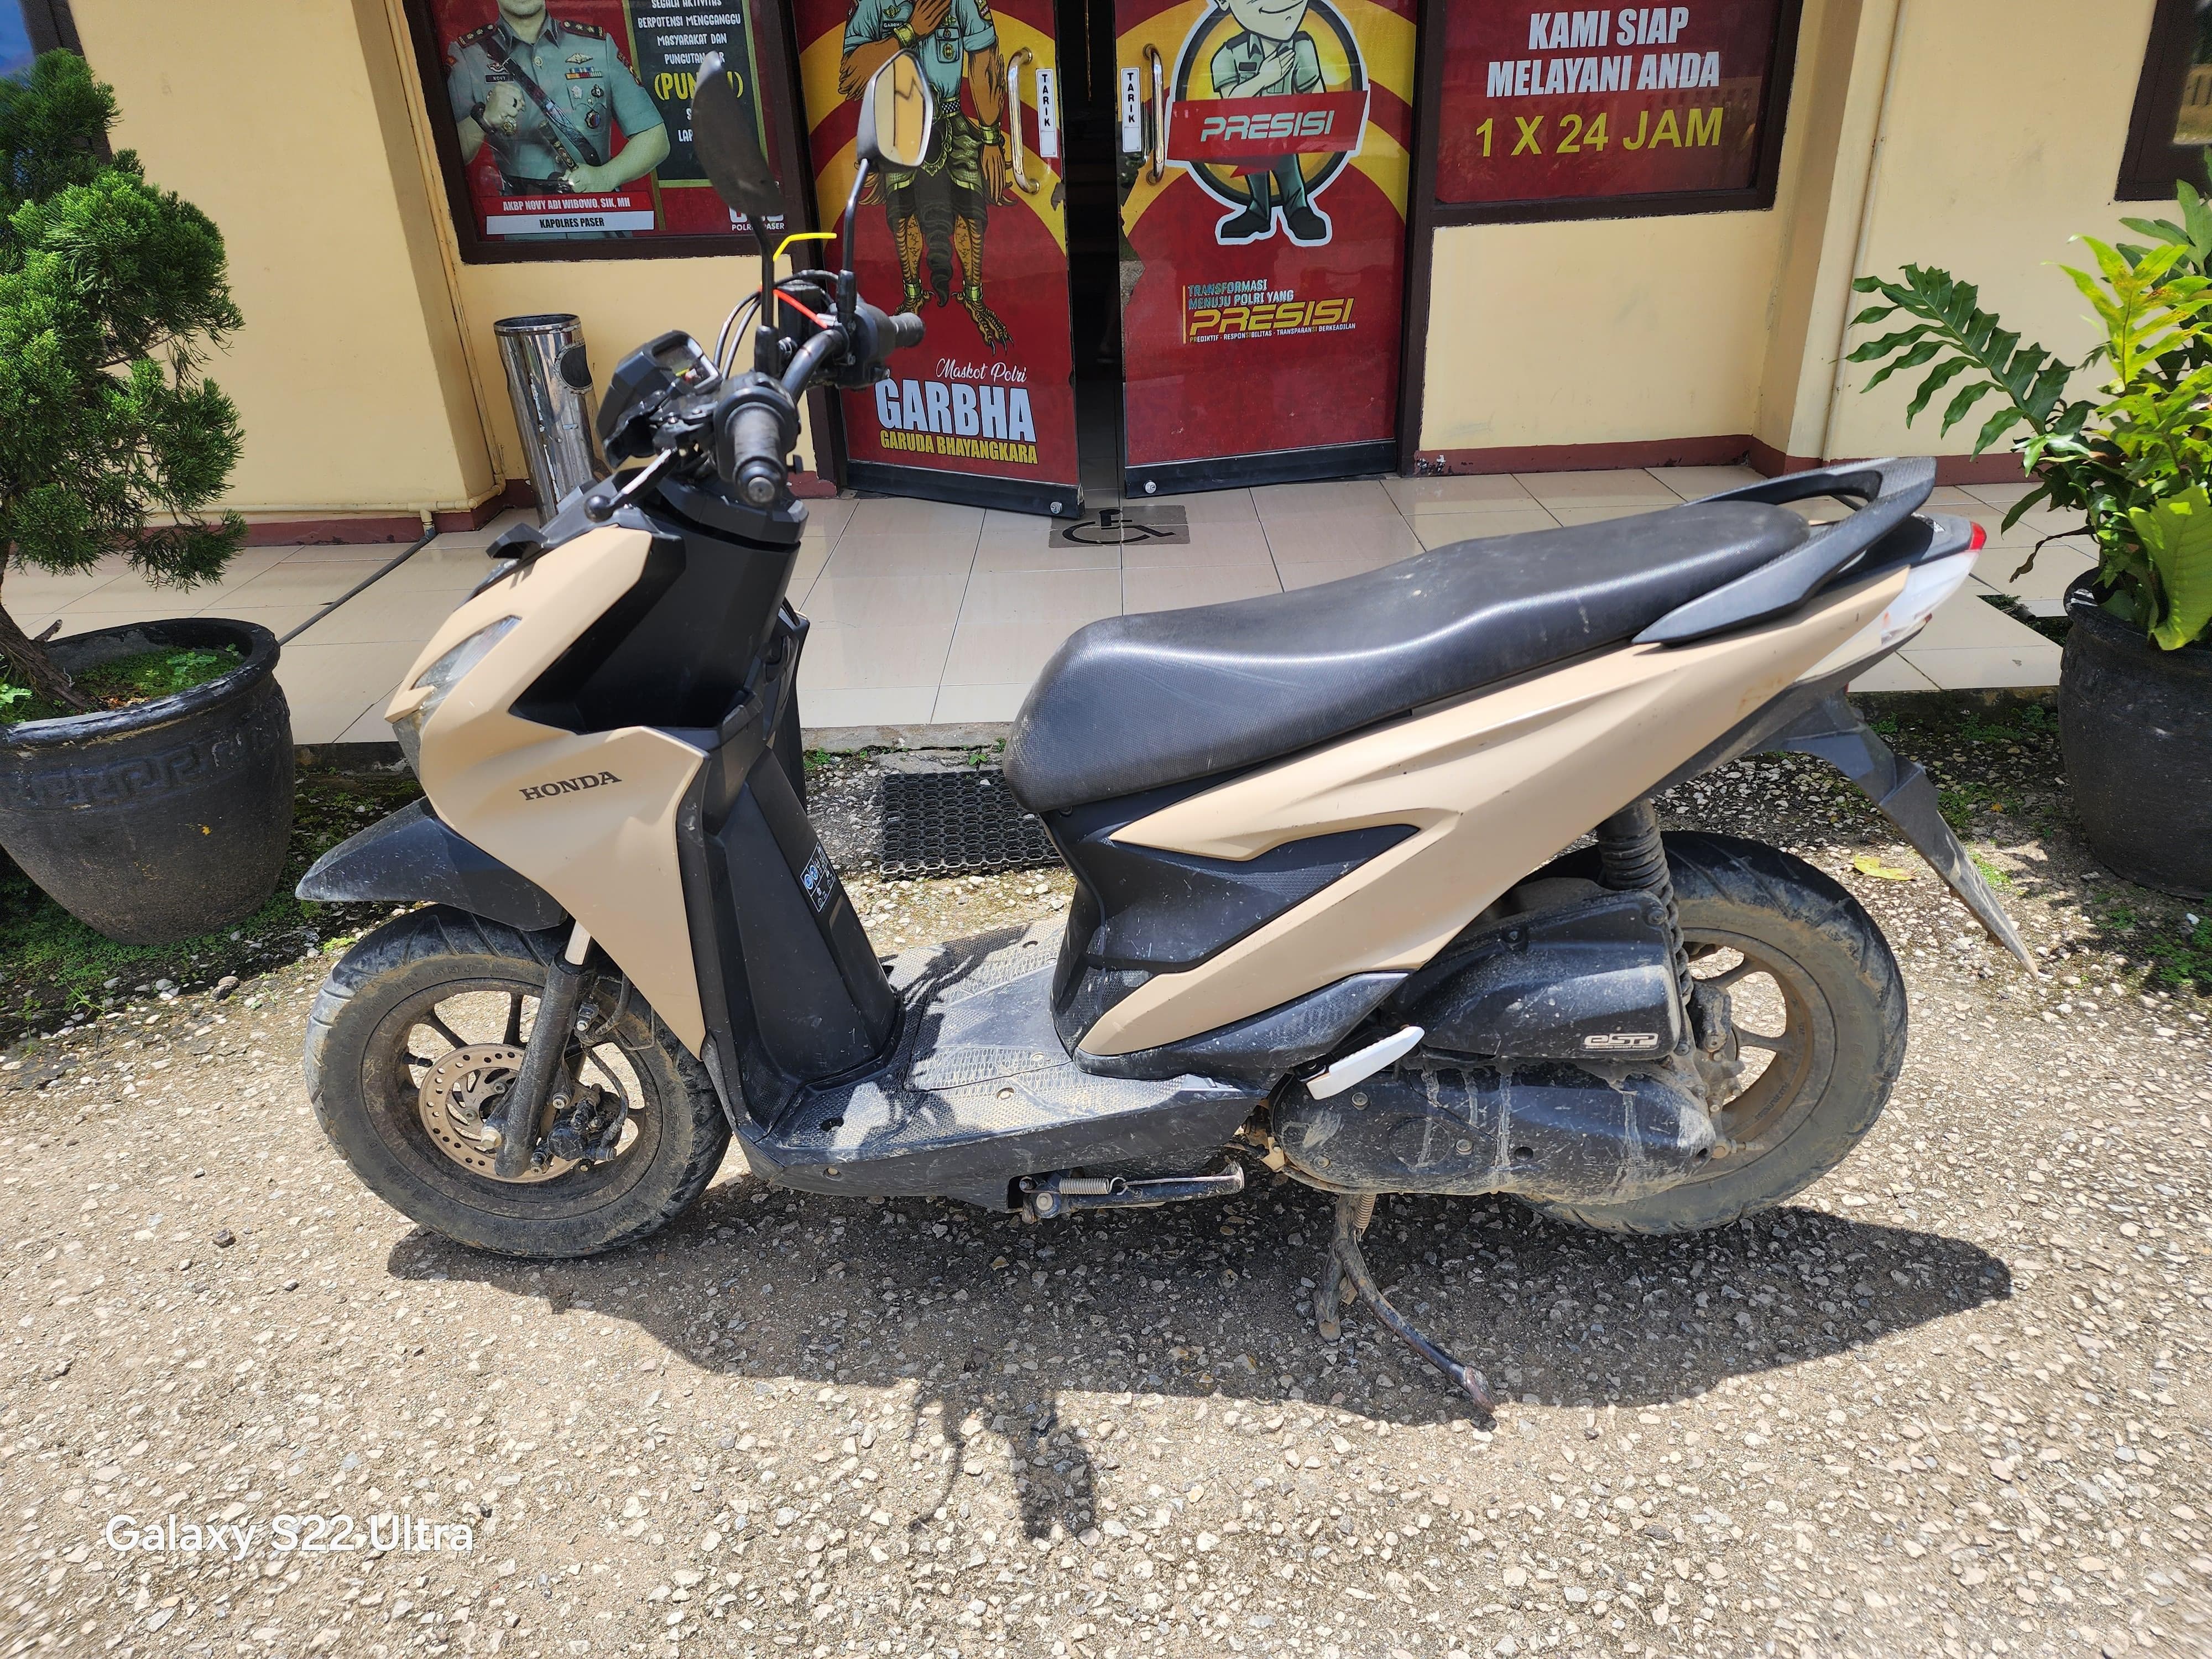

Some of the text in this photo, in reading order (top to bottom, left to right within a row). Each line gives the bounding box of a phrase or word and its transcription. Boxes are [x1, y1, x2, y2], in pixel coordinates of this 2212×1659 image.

[652, 0, 680, 9] SEGALA
[638, 13, 741, 28] BERPOTENSI MENGGANGGU
[1528, 7, 1689, 50] KAMI SIAP
[656, 33, 727, 46] MASYARAKAT DAN
[664, 52, 706, 65] PUNGUTAN
[1486, 51, 1719, 98] MELAYANI ANDA
[1042, 74, 1051, 126] TARIK
[1127, 72, 1135, 123] TARIK
[1201, 110, 1335, 142] PRESISI
[1475, 107, 1724, 156] 1 X 24 JAM
[503, 201, 524, 211] AKBP
[525, 200, 546, 211] NOVY
[562, 198, 601, 210] WIBOWO,
[617, 197, 630, 207] MH
[539, 217, 605, 228] KAPOLRES PASER
[1188, 279, 1267, 297] TRANSFORMASI
[1189, 290, 1294, 310] MENUJU POLRI YANG
[1190, 298, 1354, 336] PRESISI
[1190, 322, 1356, 343] PREDIKTIF RESPONSIBILITAS TRANSPARANSI BERKEADILAN
[936, 358, 1027, 383] Maskot Polri
[875, 377, 1037, 442] GARBHA
[880, 430, 1039, 465] GARUDA BHAYANGKARA
[519, 771, 622, 801] HONDA
